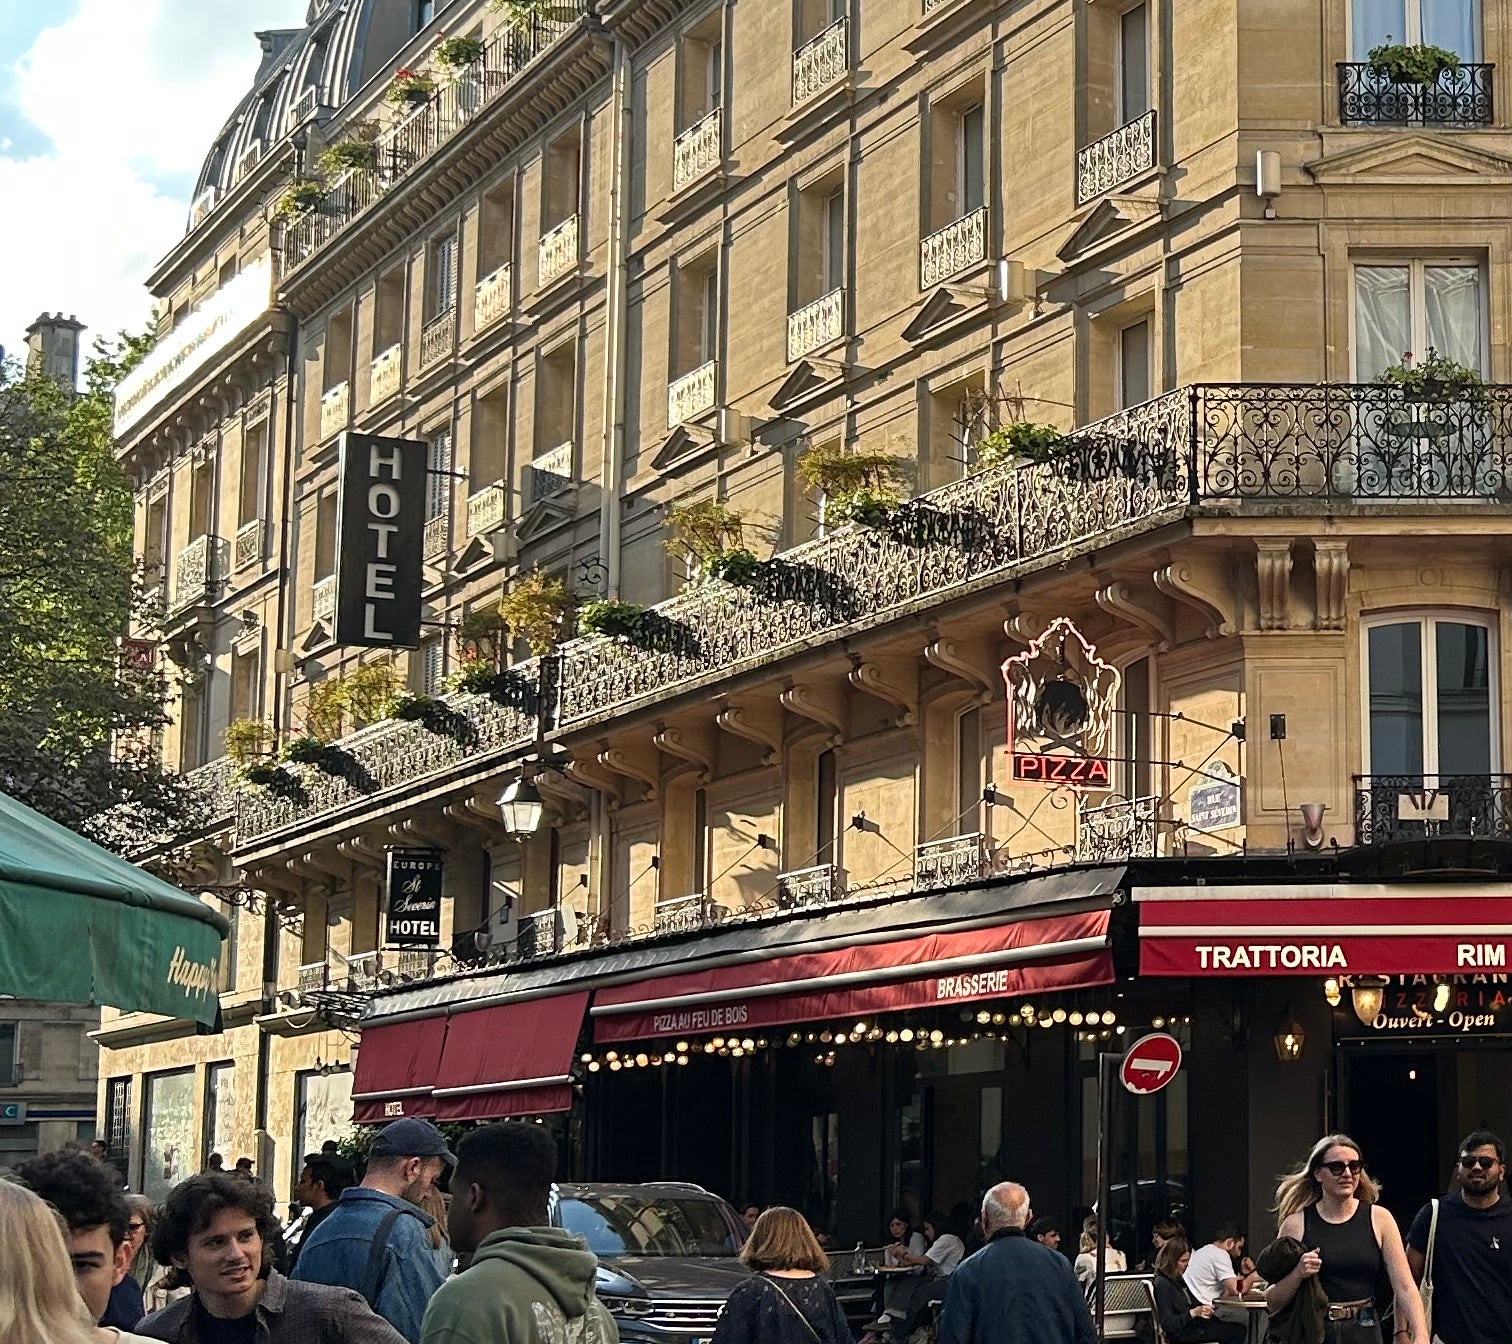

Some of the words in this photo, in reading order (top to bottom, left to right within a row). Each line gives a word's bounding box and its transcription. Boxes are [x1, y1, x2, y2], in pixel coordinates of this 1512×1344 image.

[364, 444, 402, 640] HOTEL
[1020, 757, 1108, 780] PIZZA
[389, 919, 439, 935] HOTEL
[1195, 945, 1348, 968] TRATTORIA
[1457, 944, 1506, 967] RIM
[937, 970, 1008, 999] BRASSERIE
[653, 1014, 677, 1032] PIZZA
[678, 1012, 690, 1029] AU
[692, 1010, 709, 1028] FEU
[711, 1008, 724, 1026] DE
[725, 1005, 748, 1024] BOIS
[1373, 1013, 1433, 1029] Ouvert
[1448, 1011, 1495, 1031] Open
